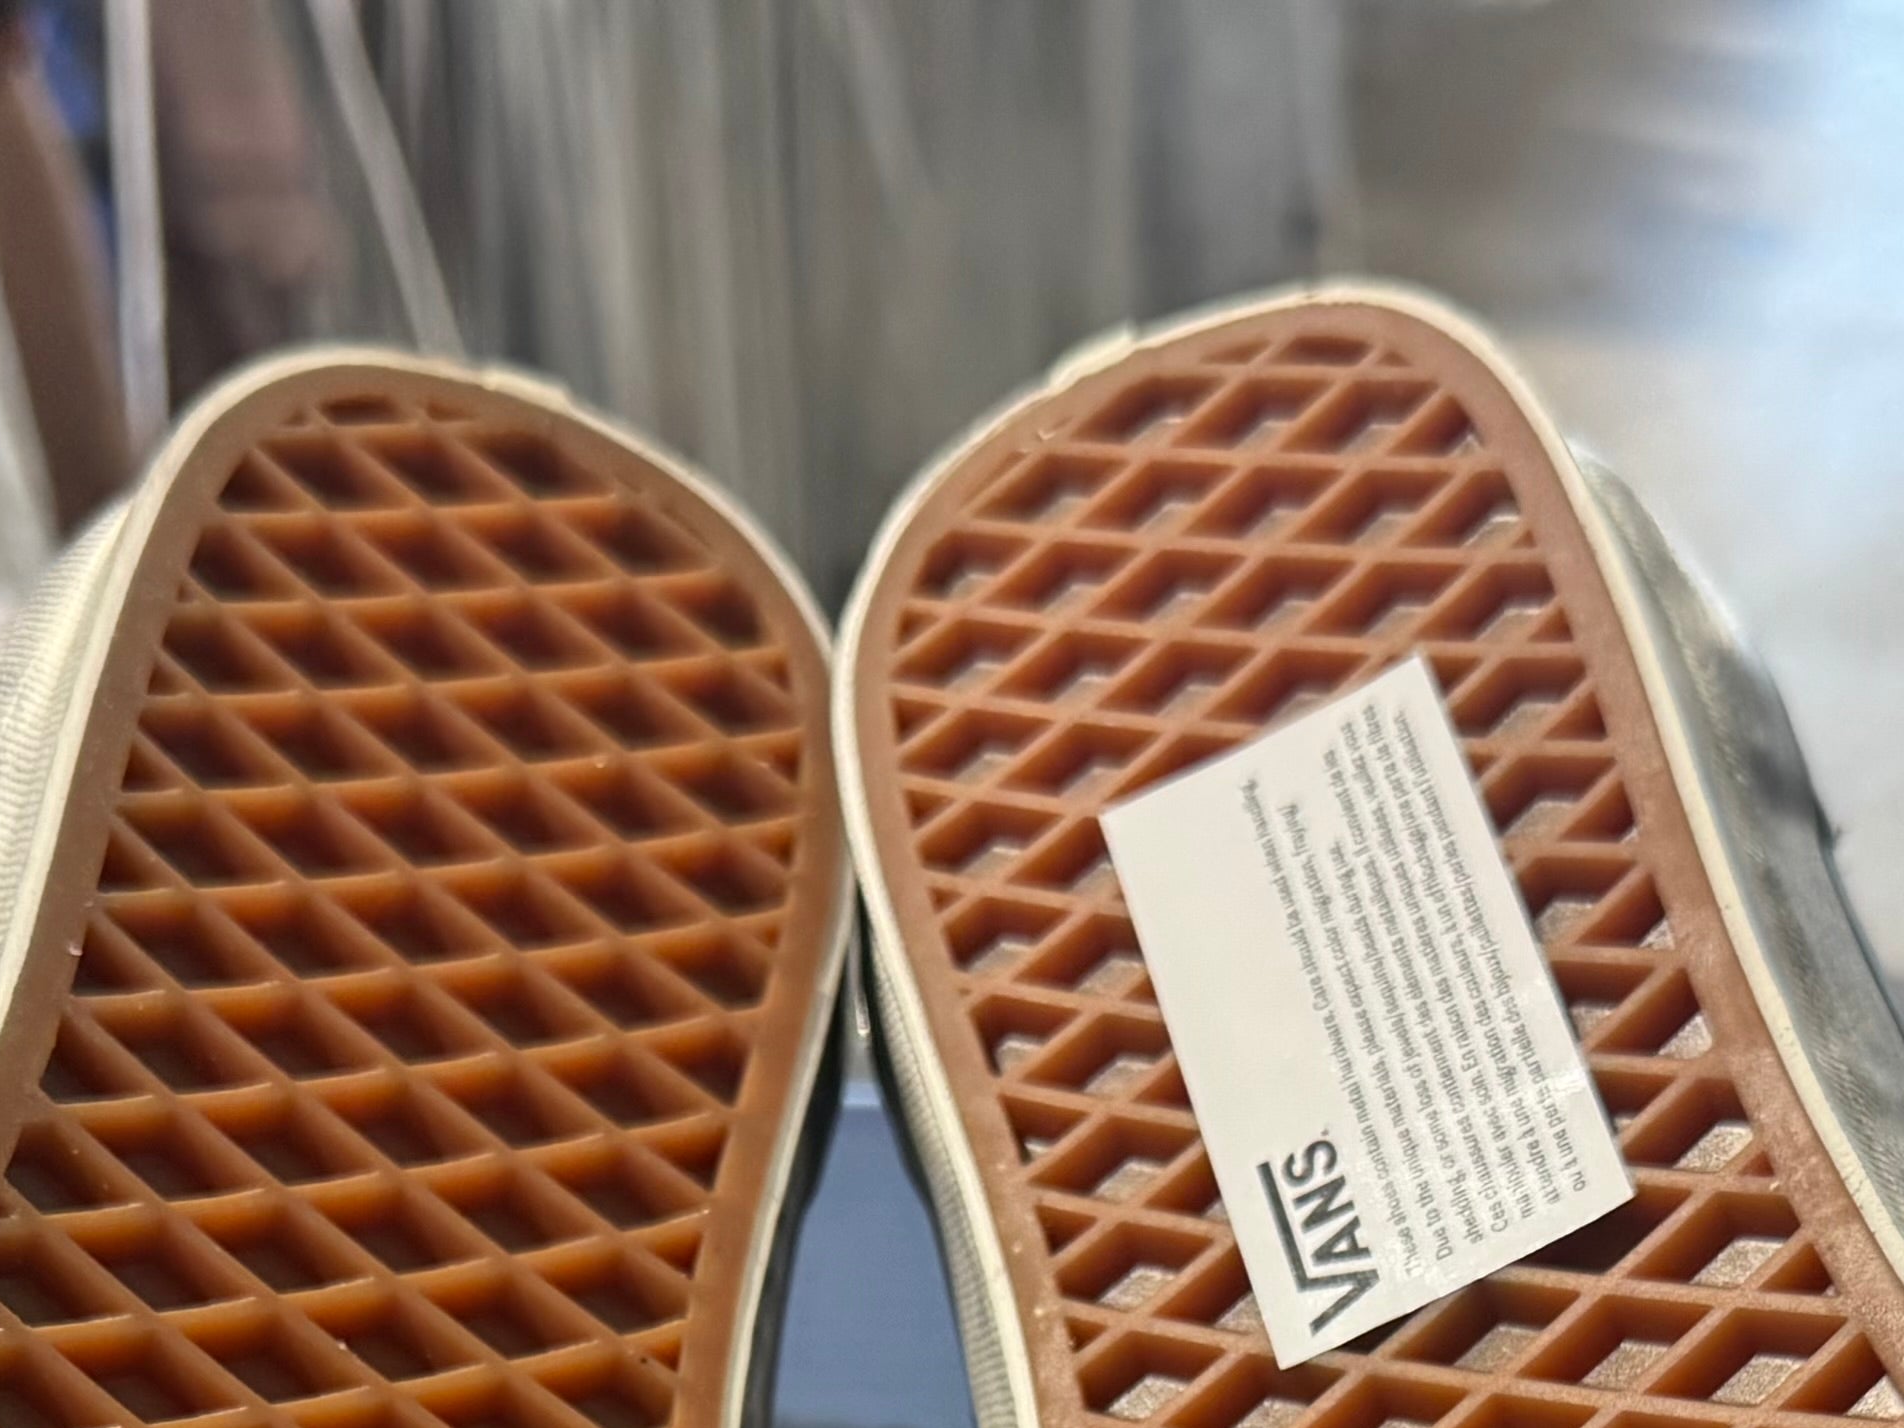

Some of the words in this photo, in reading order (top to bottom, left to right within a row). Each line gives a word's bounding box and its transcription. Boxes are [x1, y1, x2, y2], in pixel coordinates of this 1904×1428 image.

[1335, 958, 1367, 1010] expect
[1430, 976, 1454, 1007] des
[1348, 1005, 1384, 1059] please
[1400, 1059, 1423, 1083] of
[1456, 1047, 1479, 1072] En
[1477, 1024, 1523, 1100] migration
[1341, 1080, 1370, 1127] metal
[1407, 1078, 1434, 1114] loss
[1508, 1096, 1531, 1129] une
[1356, 1123, 1391, 1183] contain
[1451, 1113, 1499, 1203] chaussures
[1550, 1127, 1574, 1159] une
[1410, 1178, 1435, 1210] the
[1419, 1205, 1442, 1228] to
[1484, 1200, 1510, 1234] Ces
[1259, 1137, 1379, 1336] VANS
[1427, 1225, 1454, 1262] Due
